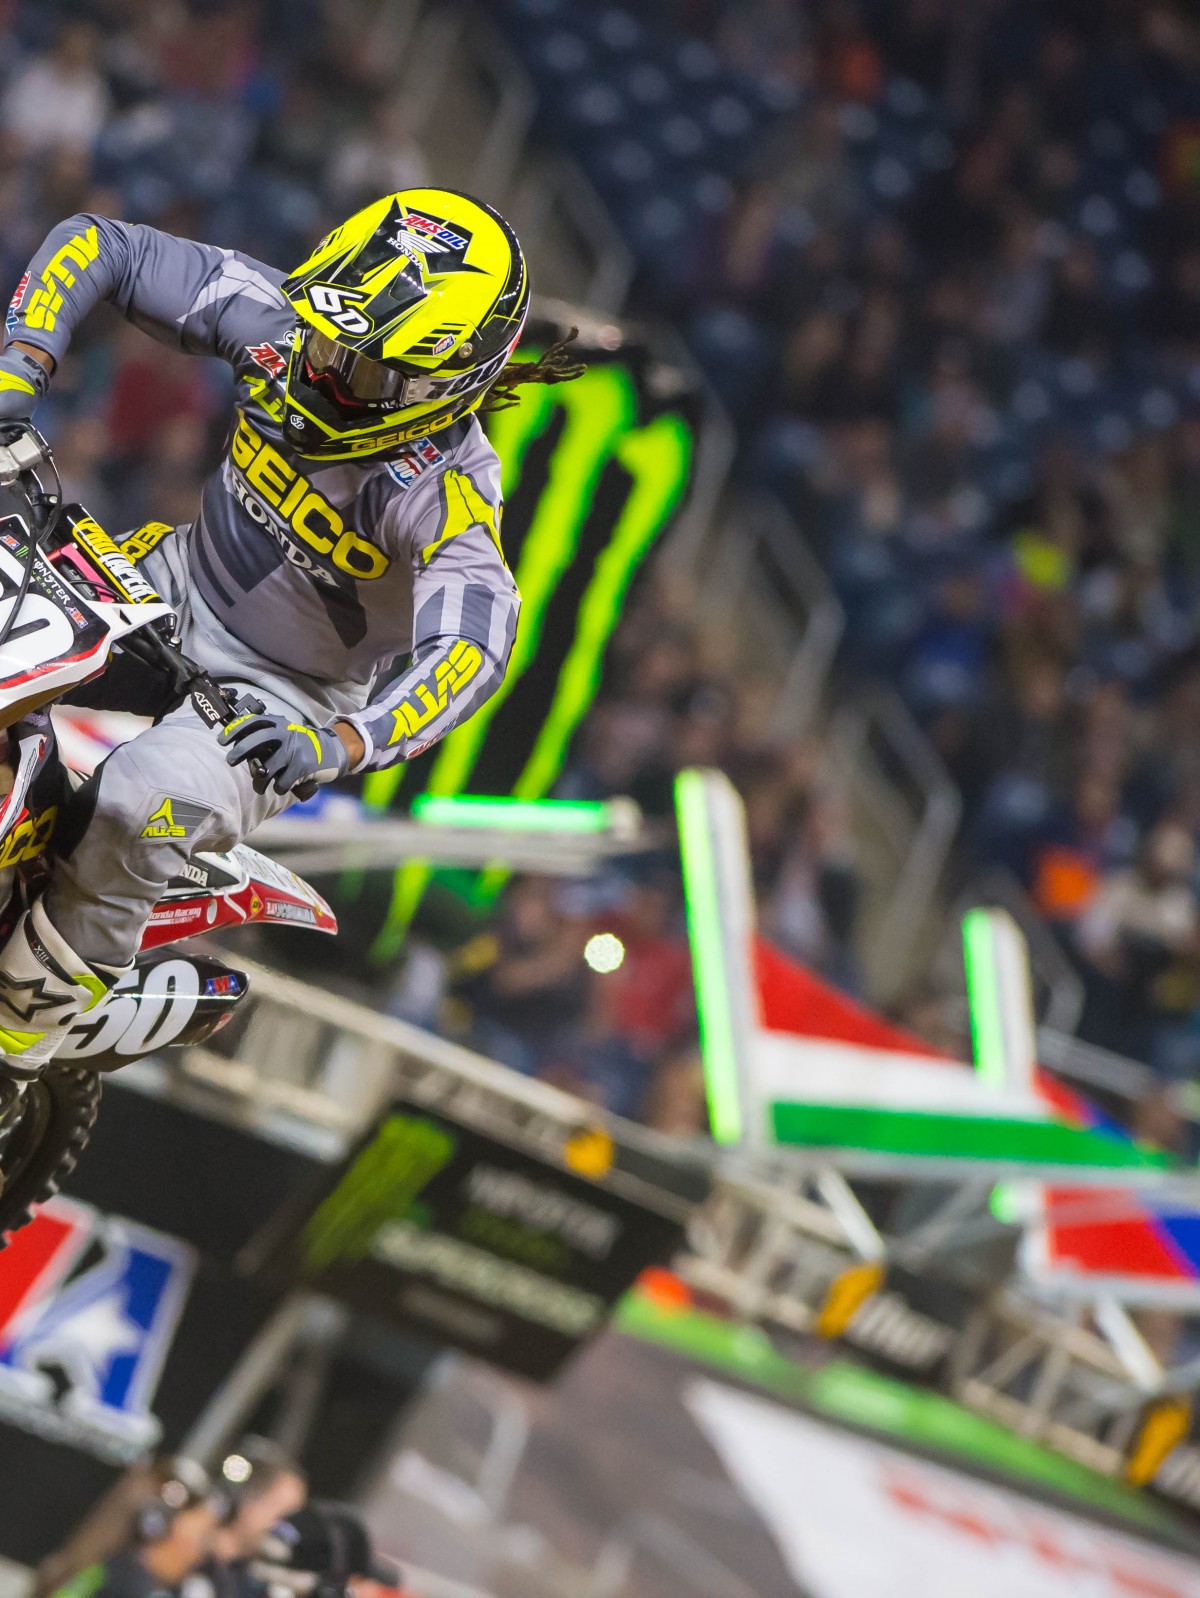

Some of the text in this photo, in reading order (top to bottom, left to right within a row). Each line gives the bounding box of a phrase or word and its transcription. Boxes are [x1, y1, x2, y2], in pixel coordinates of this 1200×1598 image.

[395, 213, 469, 250] AMSOIL
[386, 236, 424, 272] HONDA
[352, 412, 453, 452] GEICO
[232, 405, 390, 580] GEICO
[232, 469, 341, 588] HONDA
[194, 690, 221, 722] ARC
[180, 863, 209, 888] NDA
[204, 974, 241, 995] AMA
